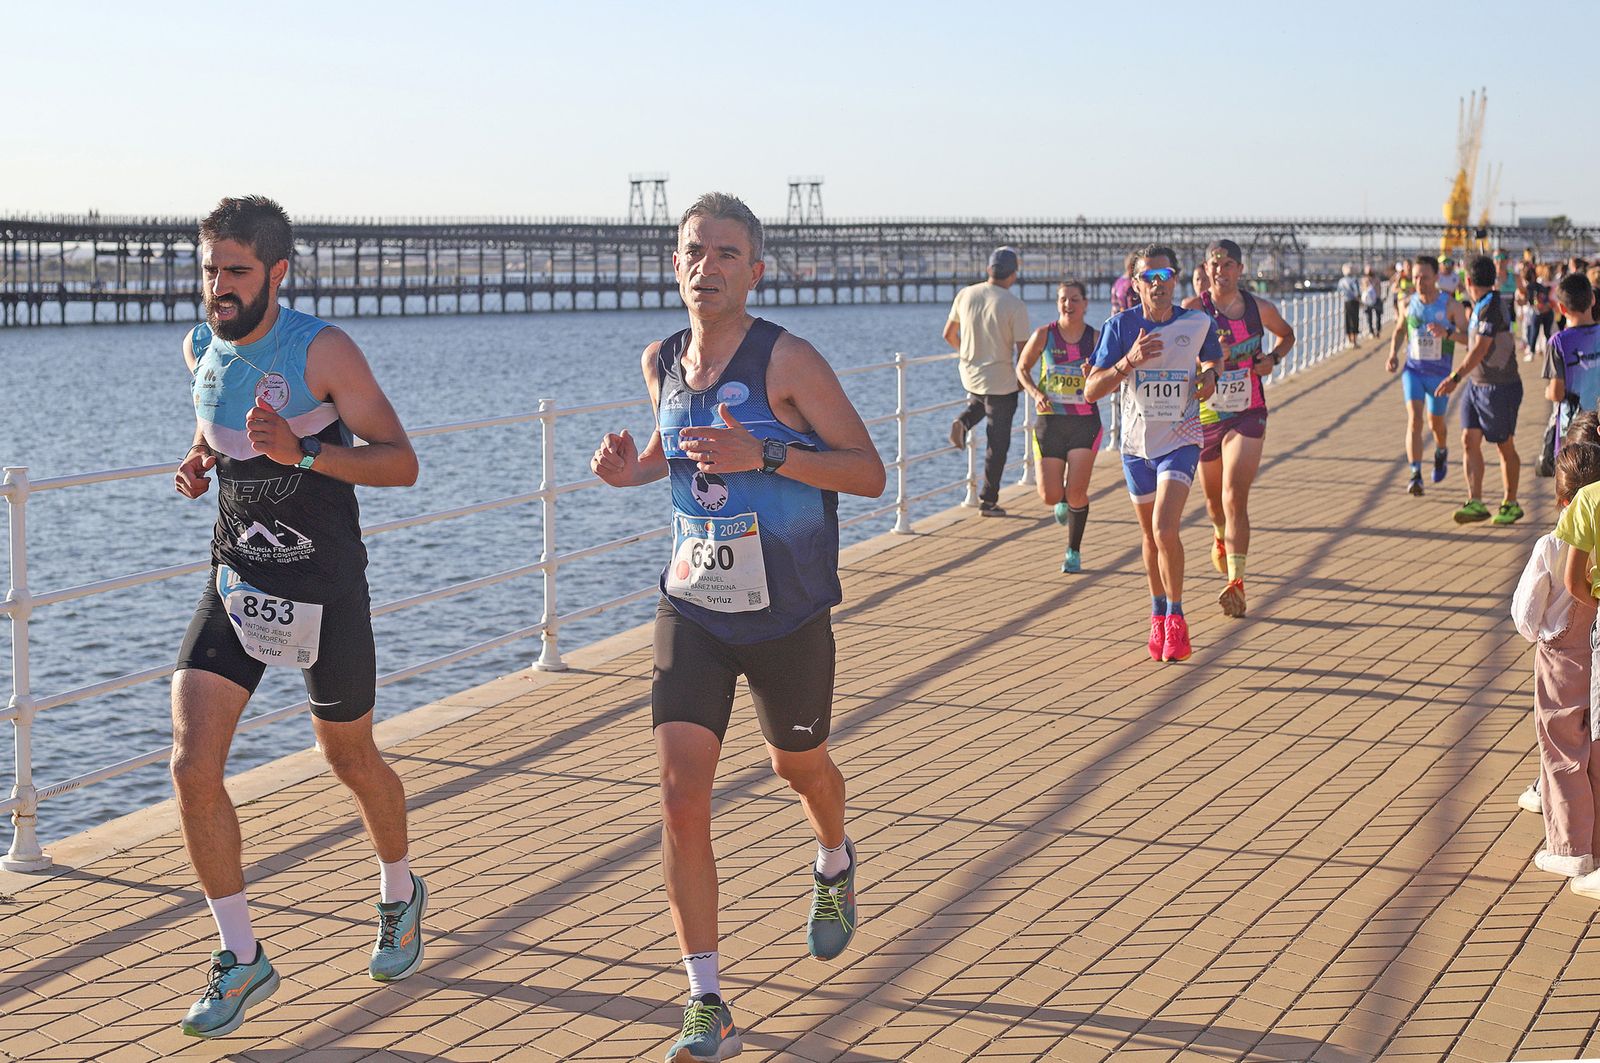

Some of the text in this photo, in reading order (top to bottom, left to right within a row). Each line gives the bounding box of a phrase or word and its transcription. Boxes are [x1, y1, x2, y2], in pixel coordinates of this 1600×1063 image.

[1143, 383, 1180, 398] 1101
[1215, 381, 1246, 395] 1752
[720, 521, 748, 538] 2023
[691, 541, 734, 571] 630
[243, 595, 295, 626] 853
